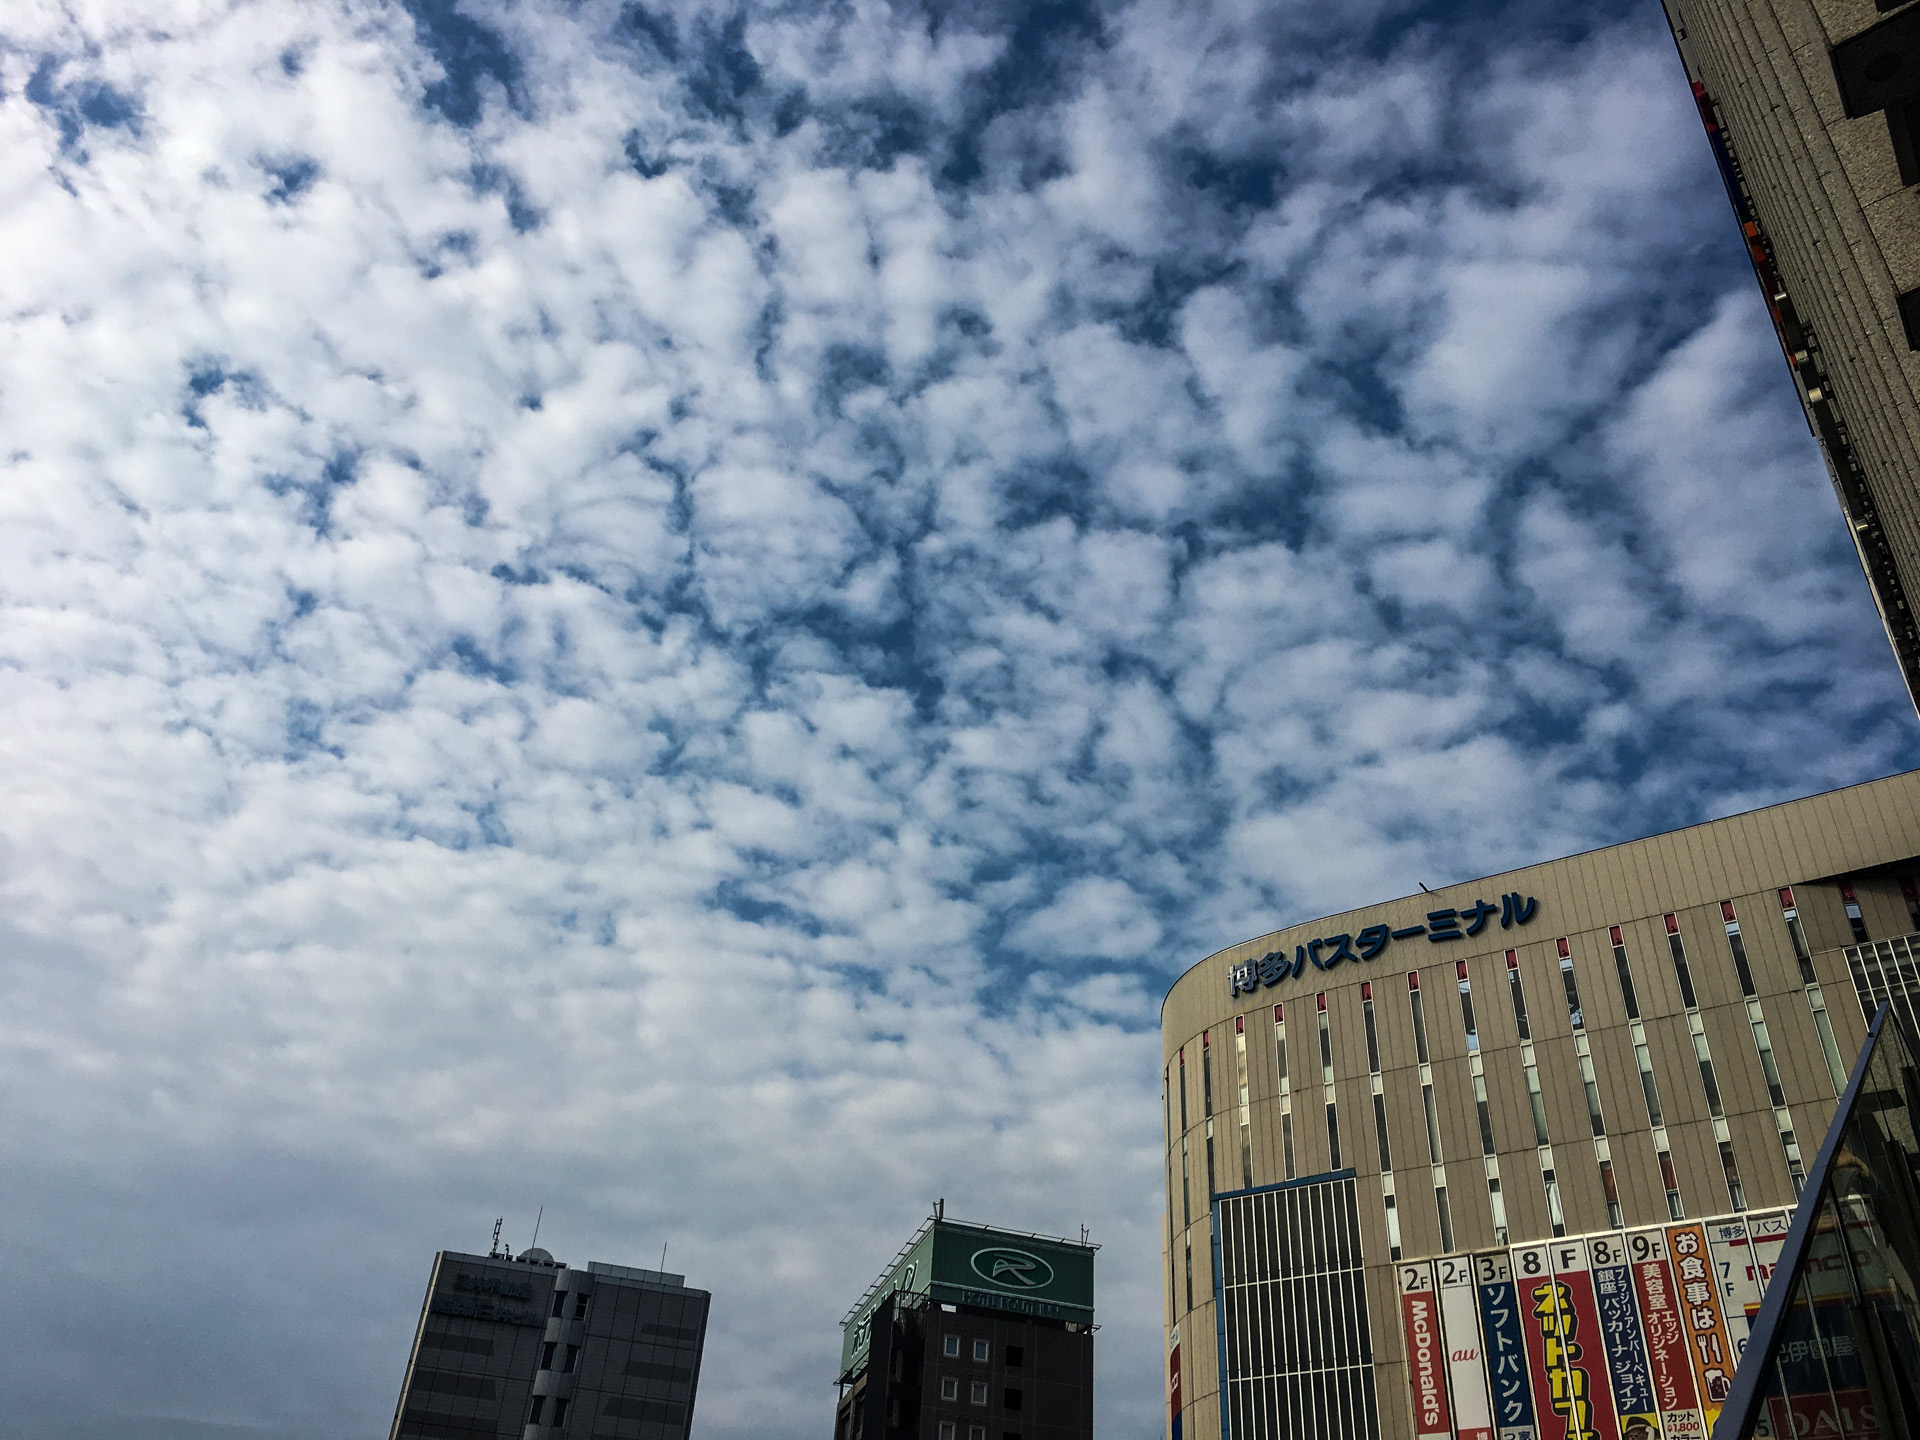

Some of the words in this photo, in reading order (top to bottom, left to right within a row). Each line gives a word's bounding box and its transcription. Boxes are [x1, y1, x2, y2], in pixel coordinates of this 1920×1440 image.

[1227, 891, 1536, 998] 博多バスターミナル
[1593, 1241, 1622, 1265] 8F
[1632, 1236, 1661, 1261] 9F
[1404, 1268, 1428, 1292] 2F
[1442, 1261, 1467, 1285] 2F
[1480, 1258, 1507, 1281] 3F
[1597, 1269, 1618, 1295] 銀座
[1674, 1231, 1716, 1330] お食事は
[1642, 1263, 1668, 1310] 美容室
[1615, 1267, 1649, 1412] ブラジリアンバーベキュー
[1661, 1310, 1680, 1345] エッジ
[1411, 1300, 1438, 1426] McDonald's
[1451, 1348, 1479, 1362] au
[1487, 1285, 1523, 1422] ソフトバンク
[1647, 1311, 1677, 1410] オリジネーション
[1667, 1411, 1695, 1423] カット
